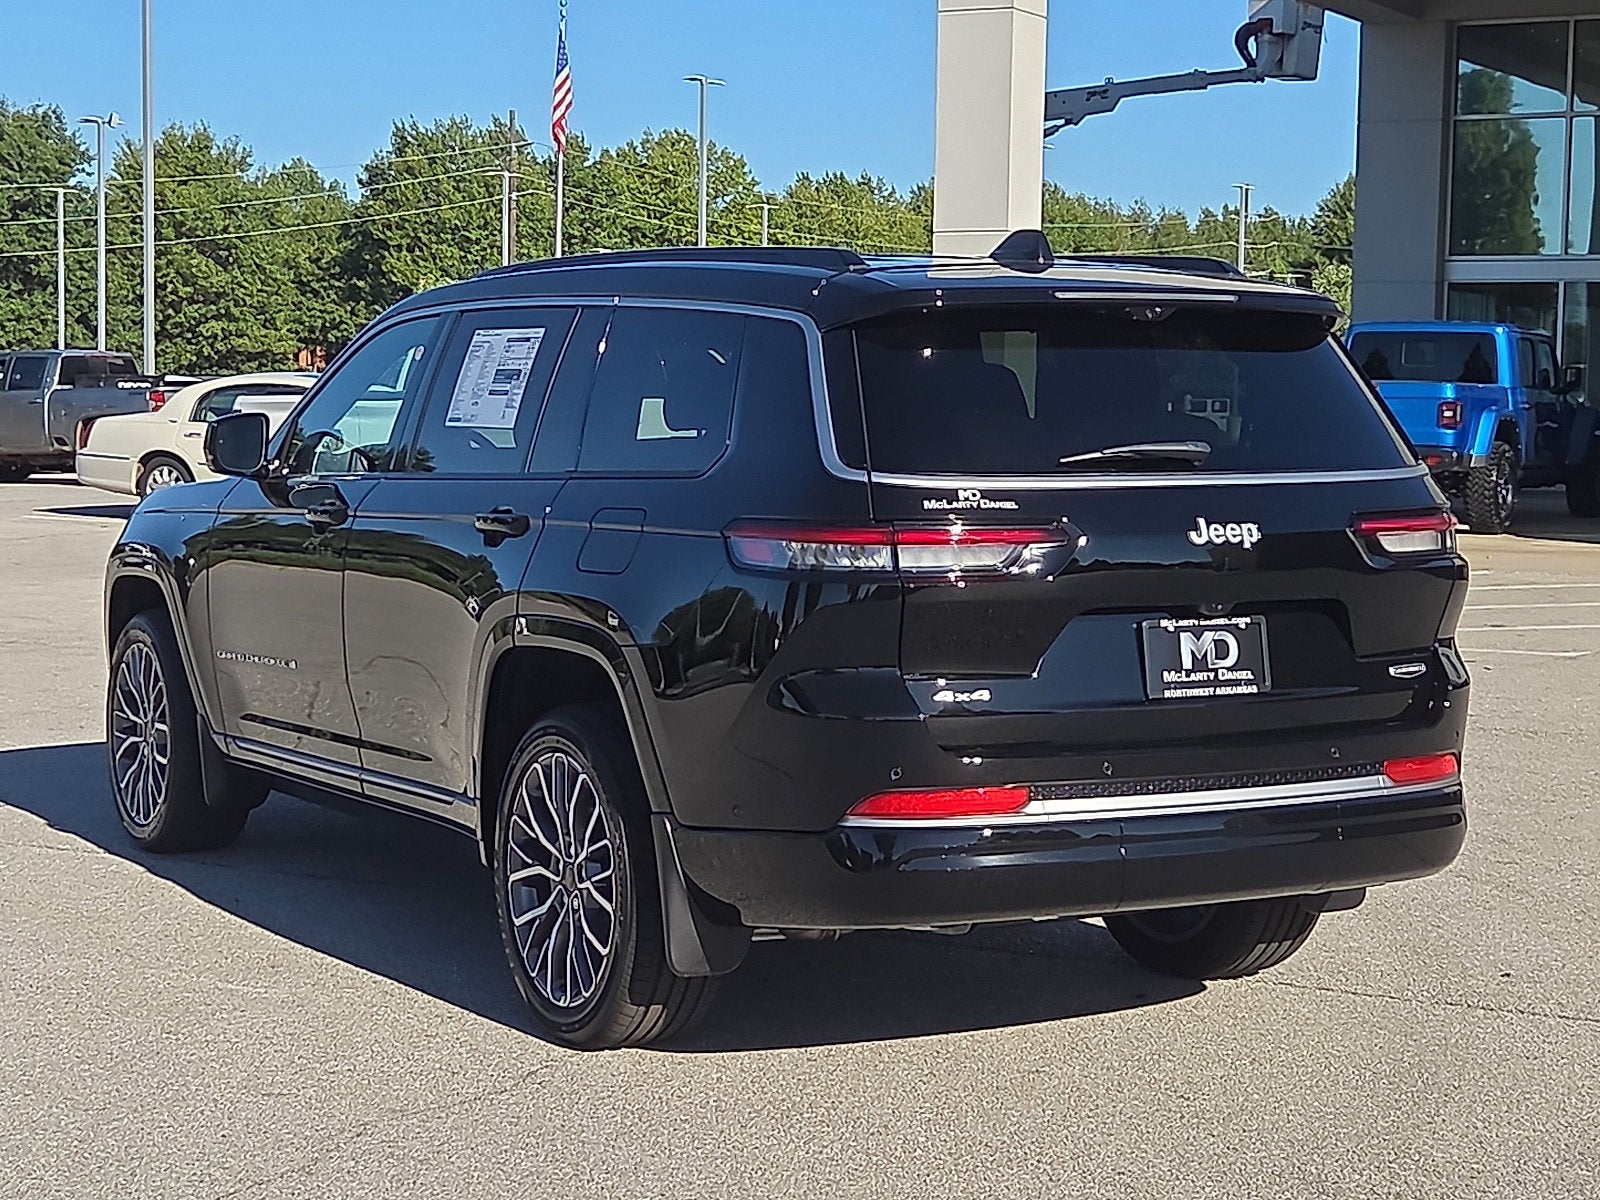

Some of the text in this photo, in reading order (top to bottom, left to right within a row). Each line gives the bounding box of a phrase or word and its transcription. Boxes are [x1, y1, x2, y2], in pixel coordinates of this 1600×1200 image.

[1187, 516, 1260, 549] Jeep
[1179, 630, 1239, 670] MD
[932, 688, 992, 703] 4x4
